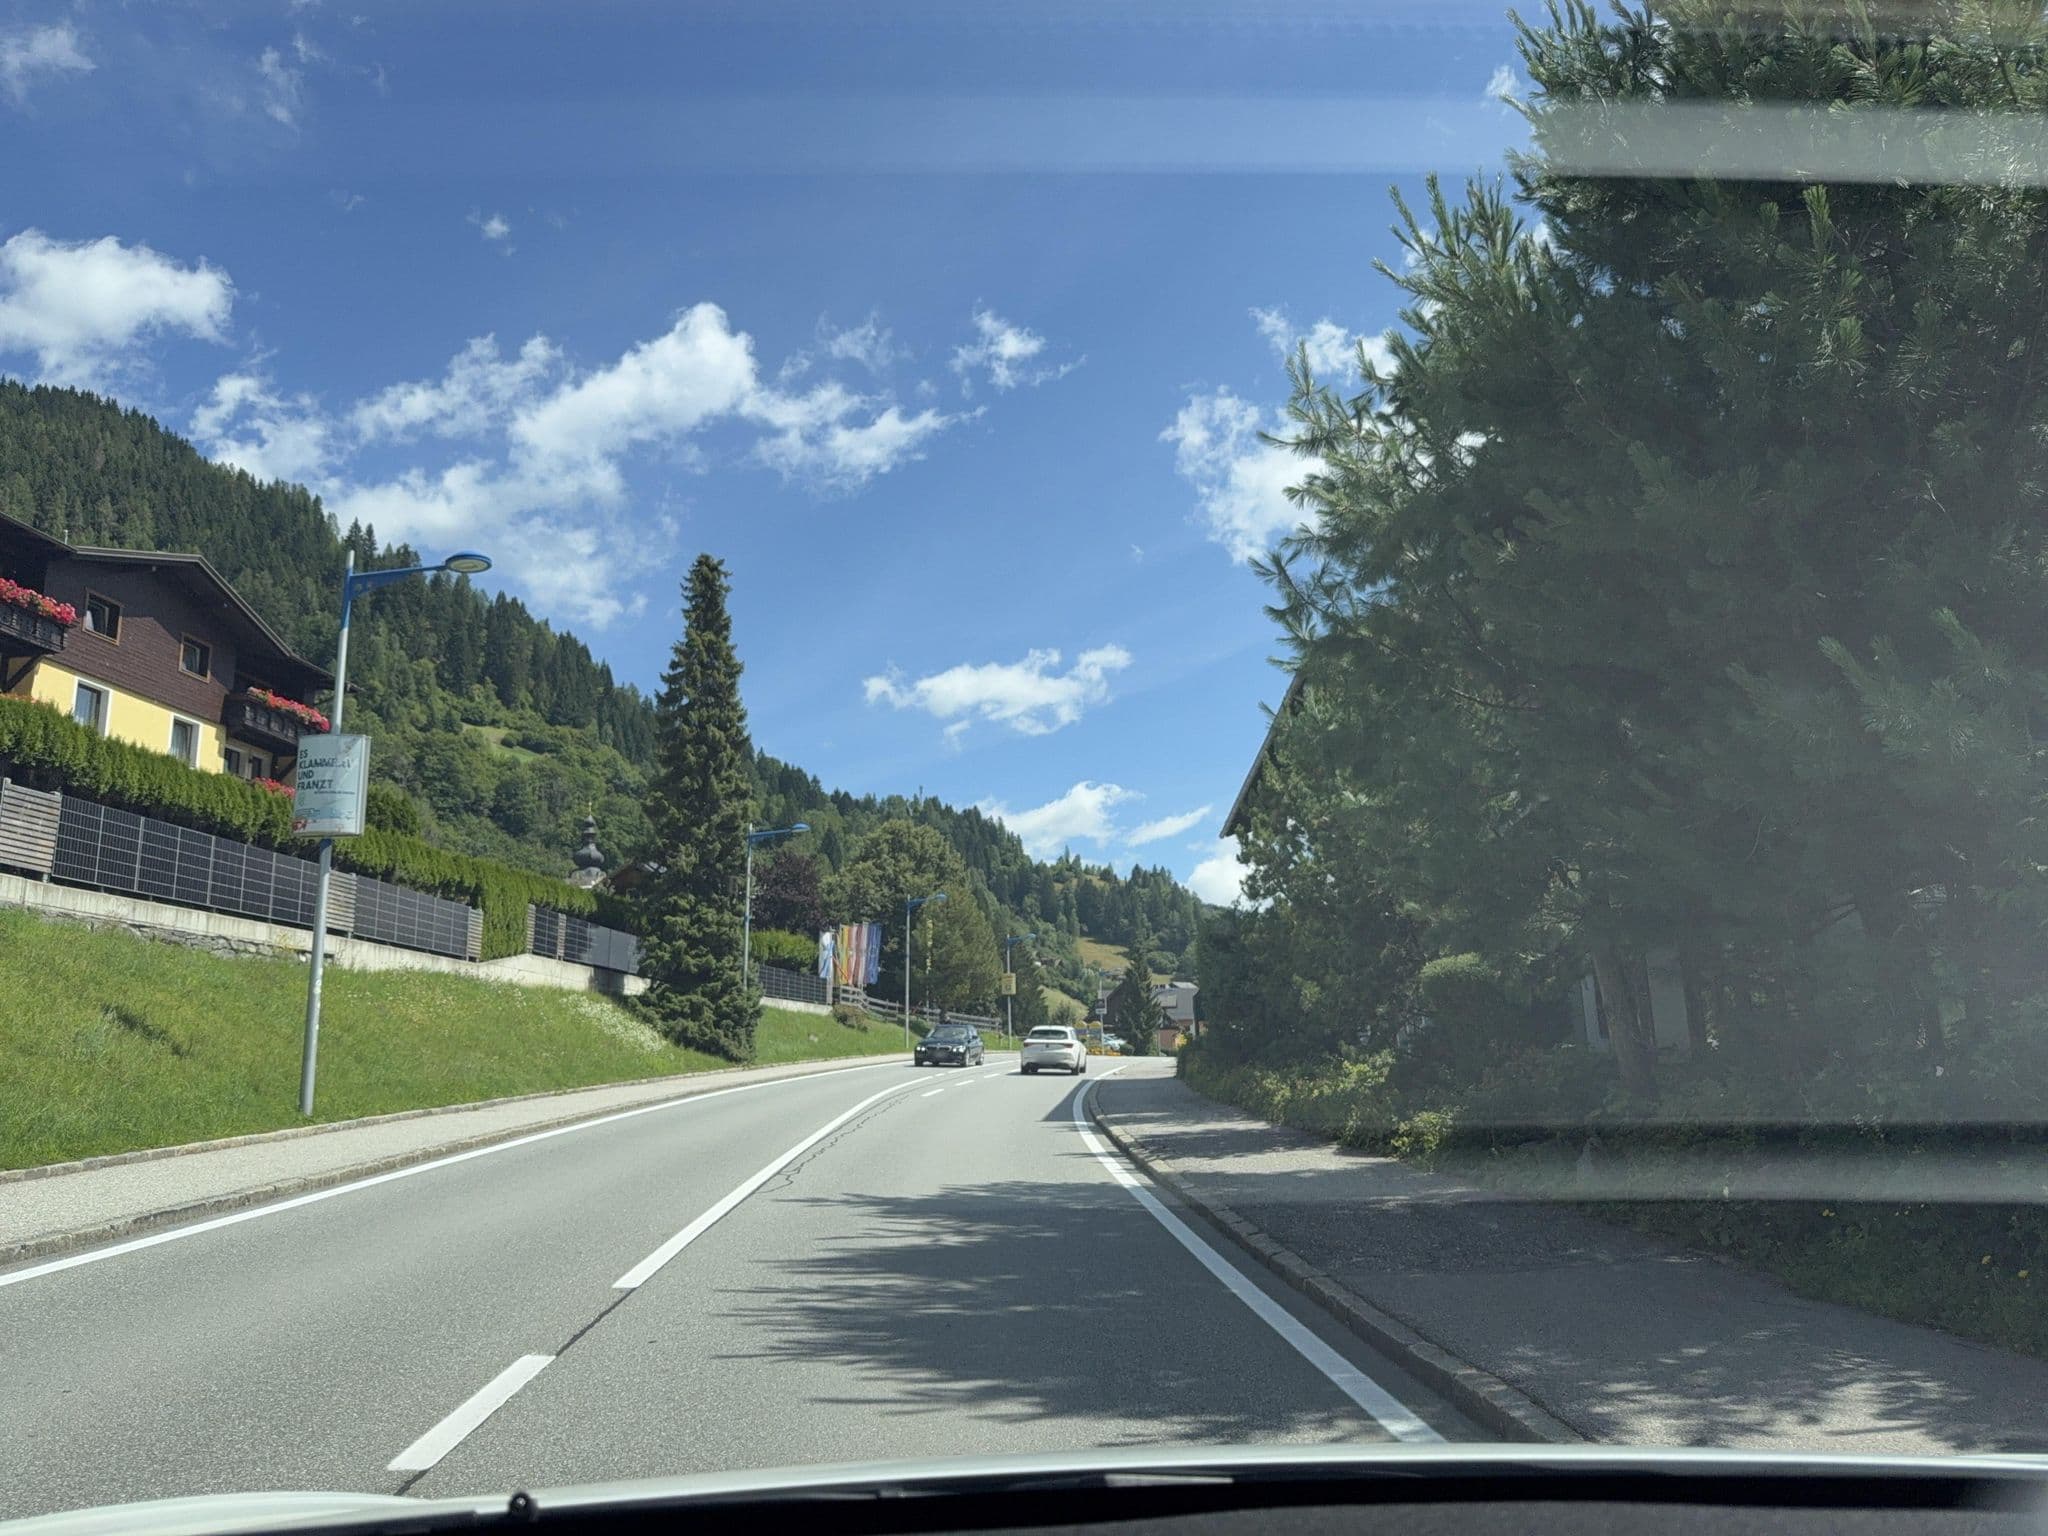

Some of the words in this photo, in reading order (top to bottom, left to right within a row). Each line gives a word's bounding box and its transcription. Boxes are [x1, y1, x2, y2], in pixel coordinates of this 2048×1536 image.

[299, 757, 352, 769] KLAMME
[297, 769, 314, 780] UND
[297, 779, 334, 790] FRANZT
